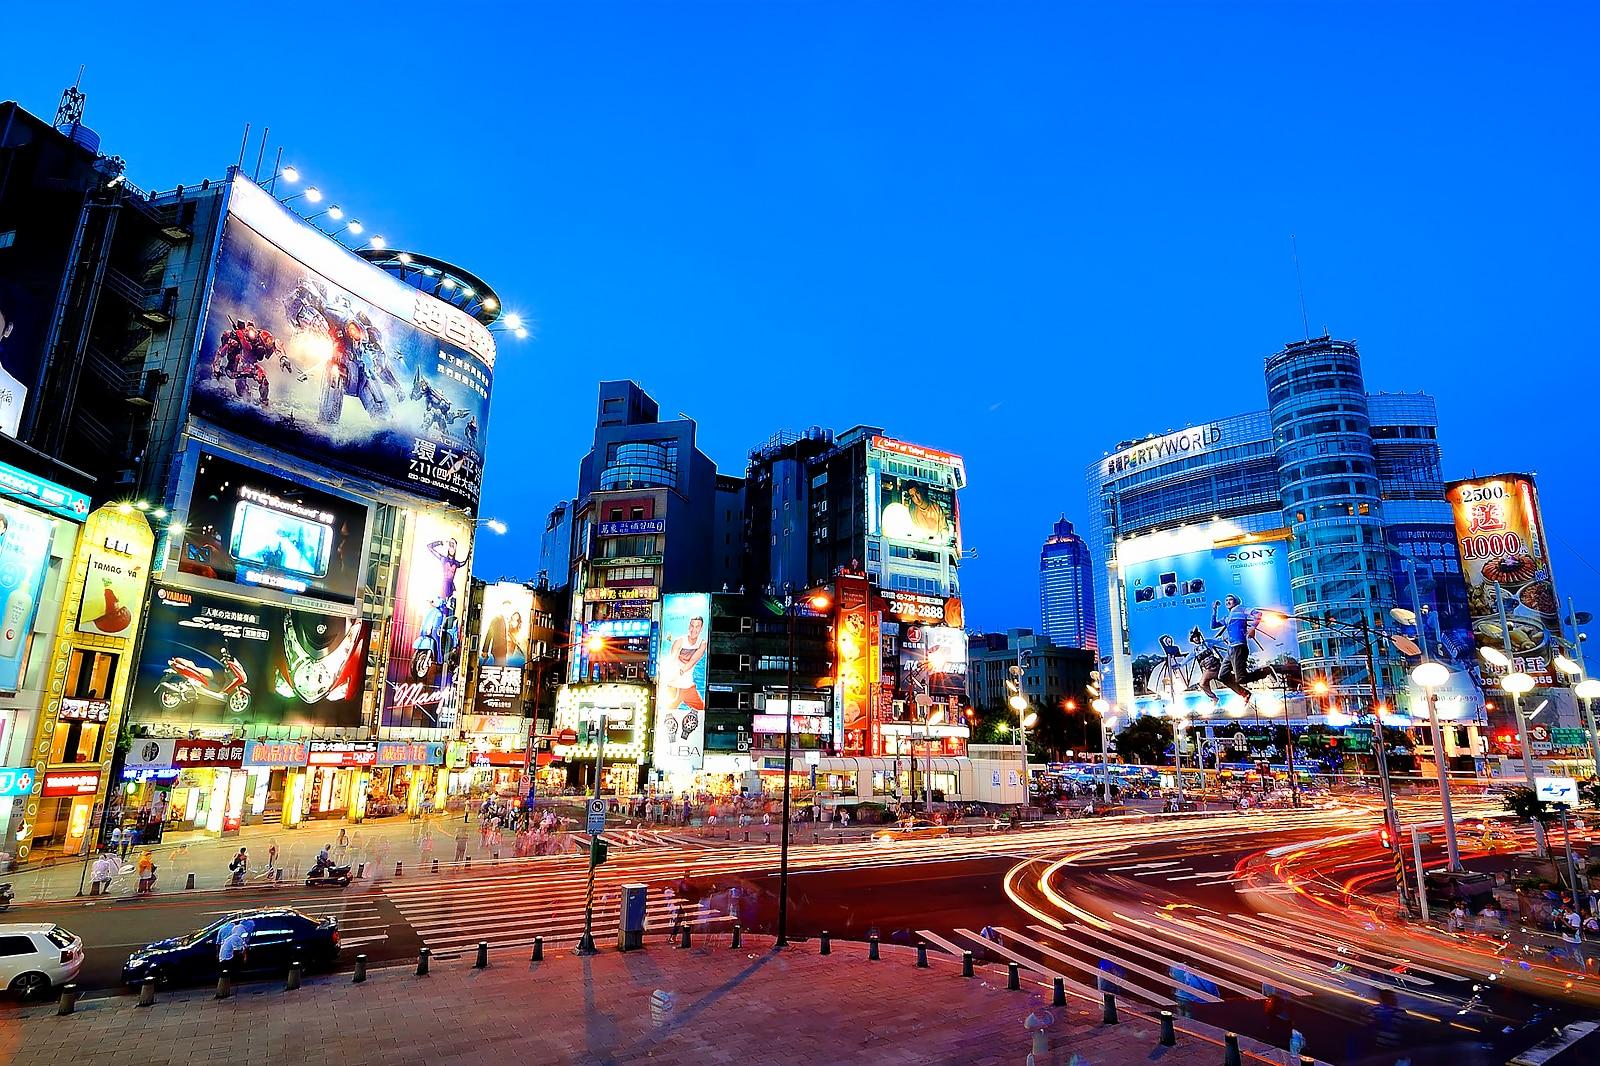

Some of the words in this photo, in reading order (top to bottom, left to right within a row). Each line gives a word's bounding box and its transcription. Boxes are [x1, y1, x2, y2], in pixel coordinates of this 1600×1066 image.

[1462, 487, 1503, 503] 2500
[1469, 503, 1506, 534] 送
[1462, 532, 1520, 561] 1000
[1226, 548, 1277, 562] SONY
[166, 590, 193, 604] YAMAHA
[889, 600, 944, 619] 2978-2888
[175, 747, 243, 761] 真善美劇院
